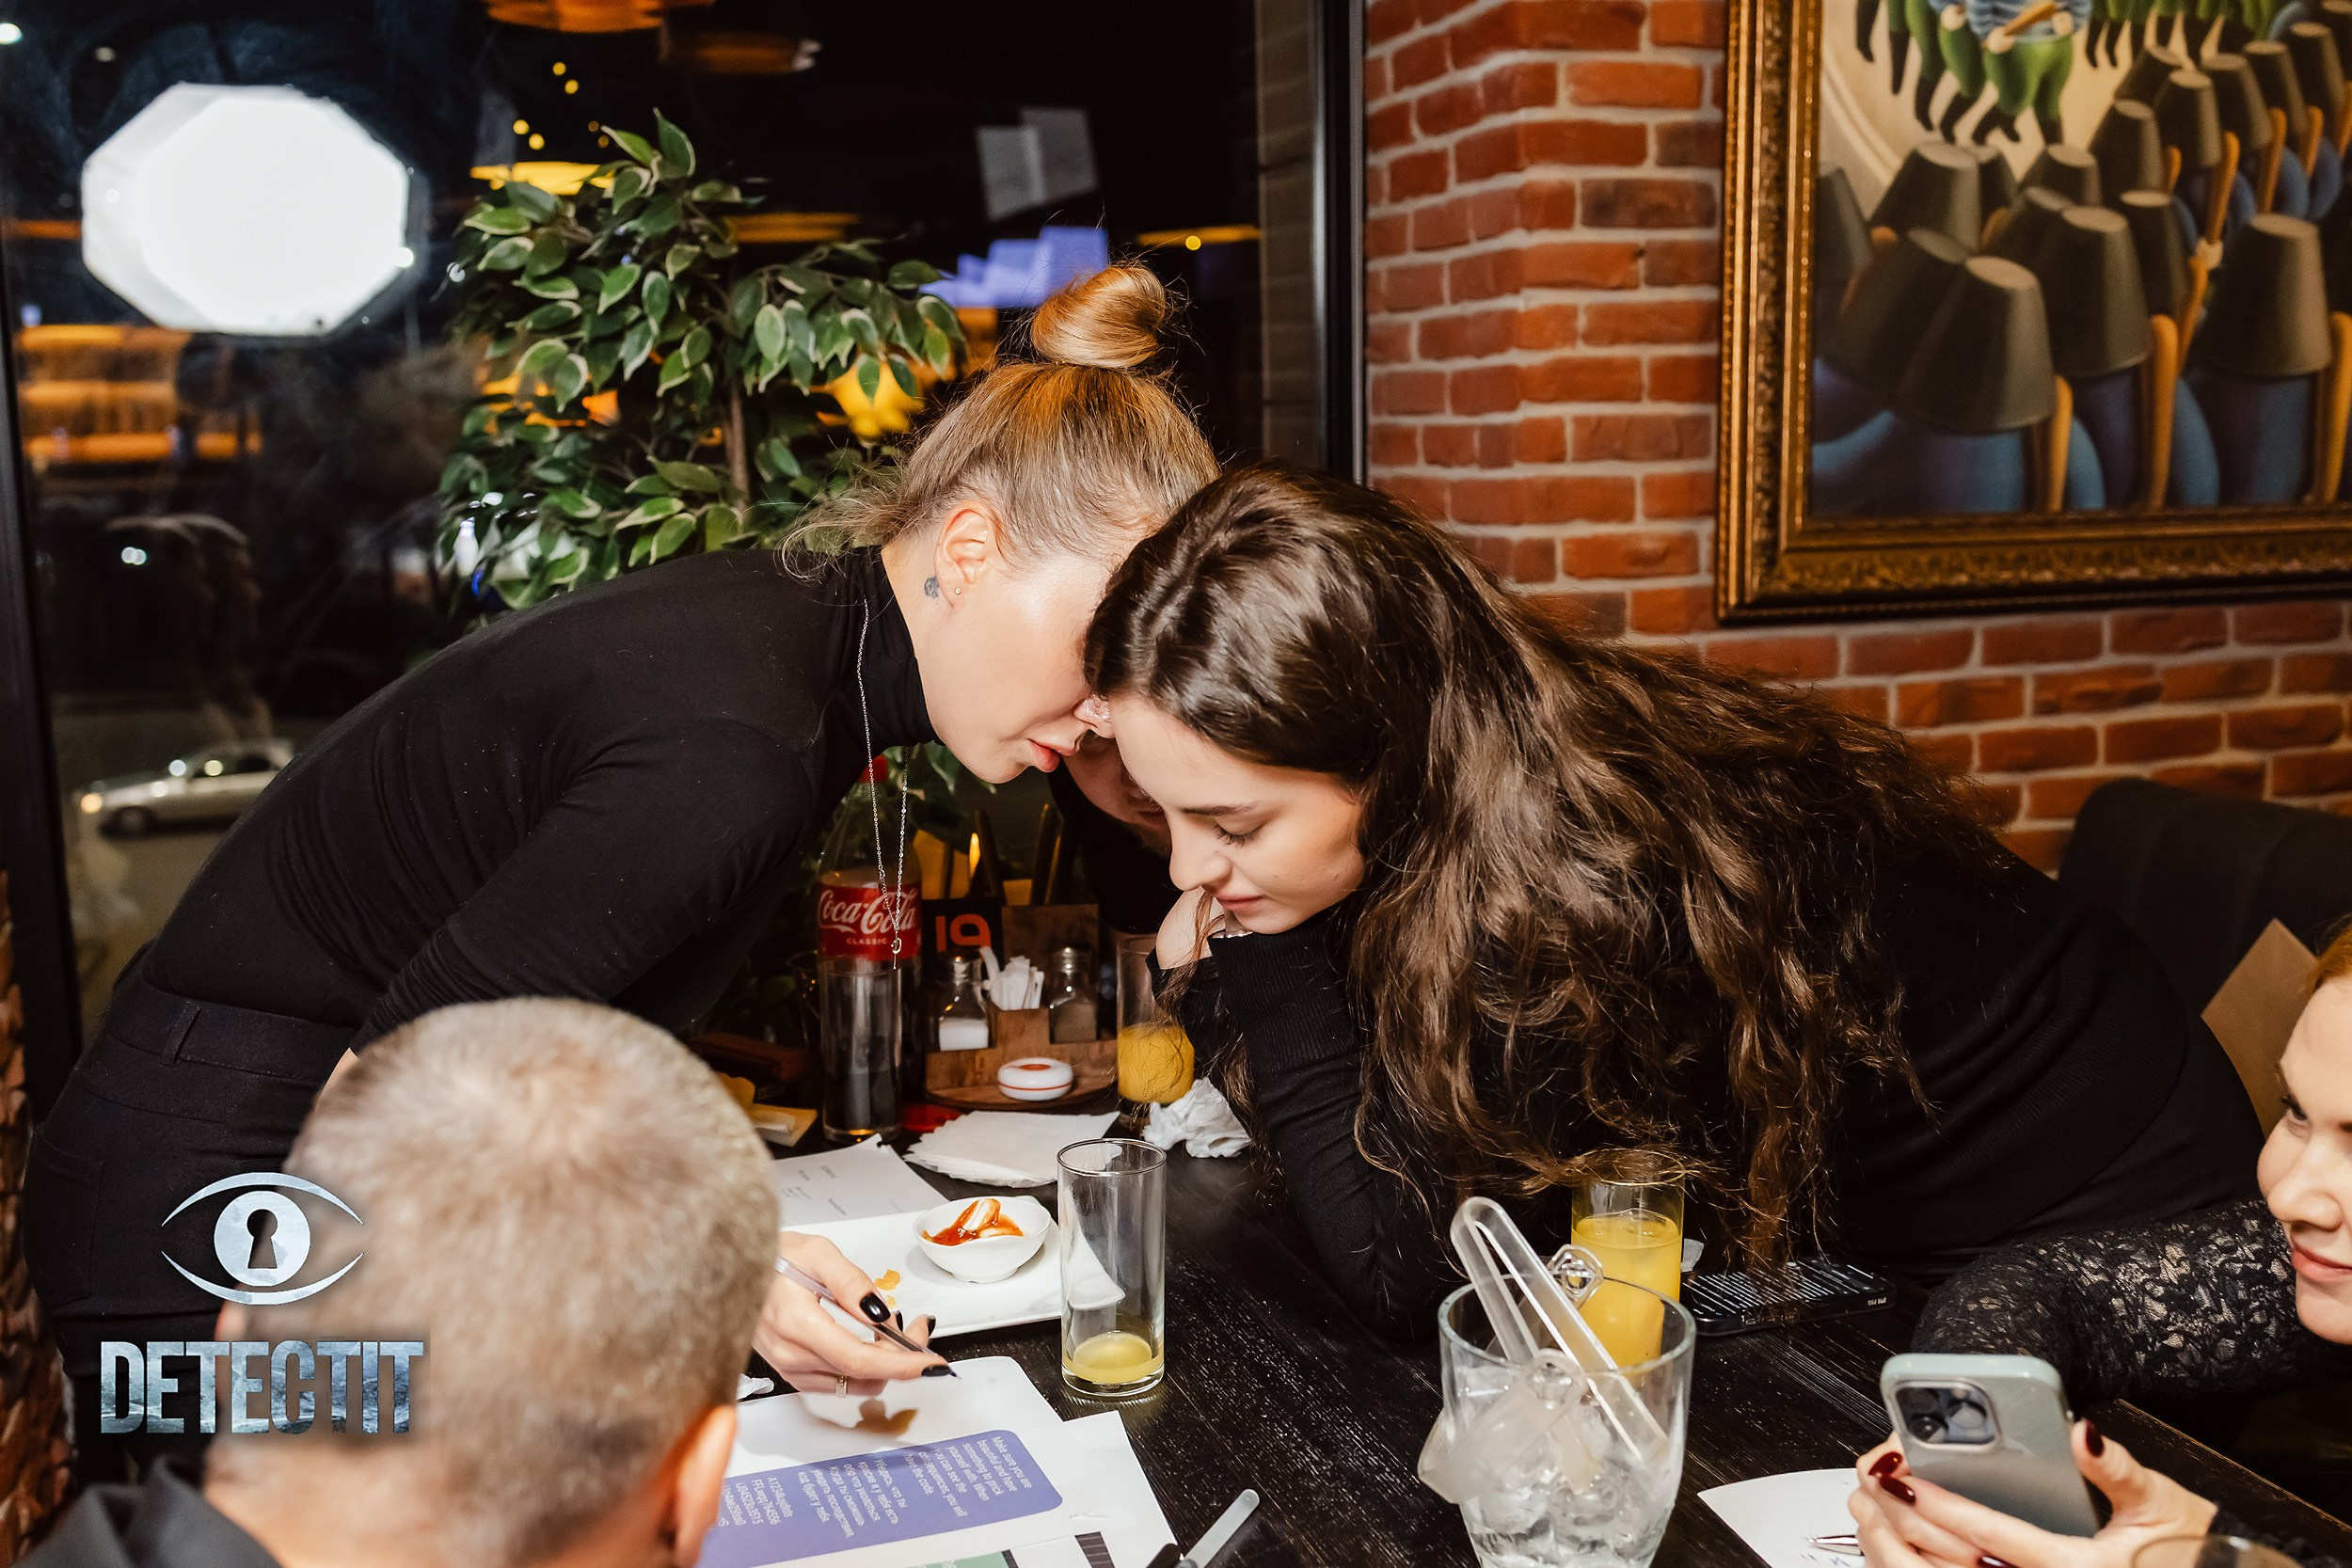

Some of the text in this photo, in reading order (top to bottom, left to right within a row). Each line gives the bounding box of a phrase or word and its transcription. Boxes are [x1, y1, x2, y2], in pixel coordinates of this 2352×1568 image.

[818, 888, 918, 934] Coca-Cola
[846, 937, 888, 945] CLASSIC
[914, 1468, 924, 1480] the
[946, 1447, 971, 1469] yourself
[974, 1483, 990, 1501] When
[963, 1444, 988, 1474] something
[978, 1440, 1017, 1492] beautiful and have
[993, 1437, 1032, 1489] Make sure you are
[942, 1461, 953, 1472] can
[948, 1472, 960, 1482] see
[956, 1482, 967, 1494] the
[943, 1495, 959, 1506] you
